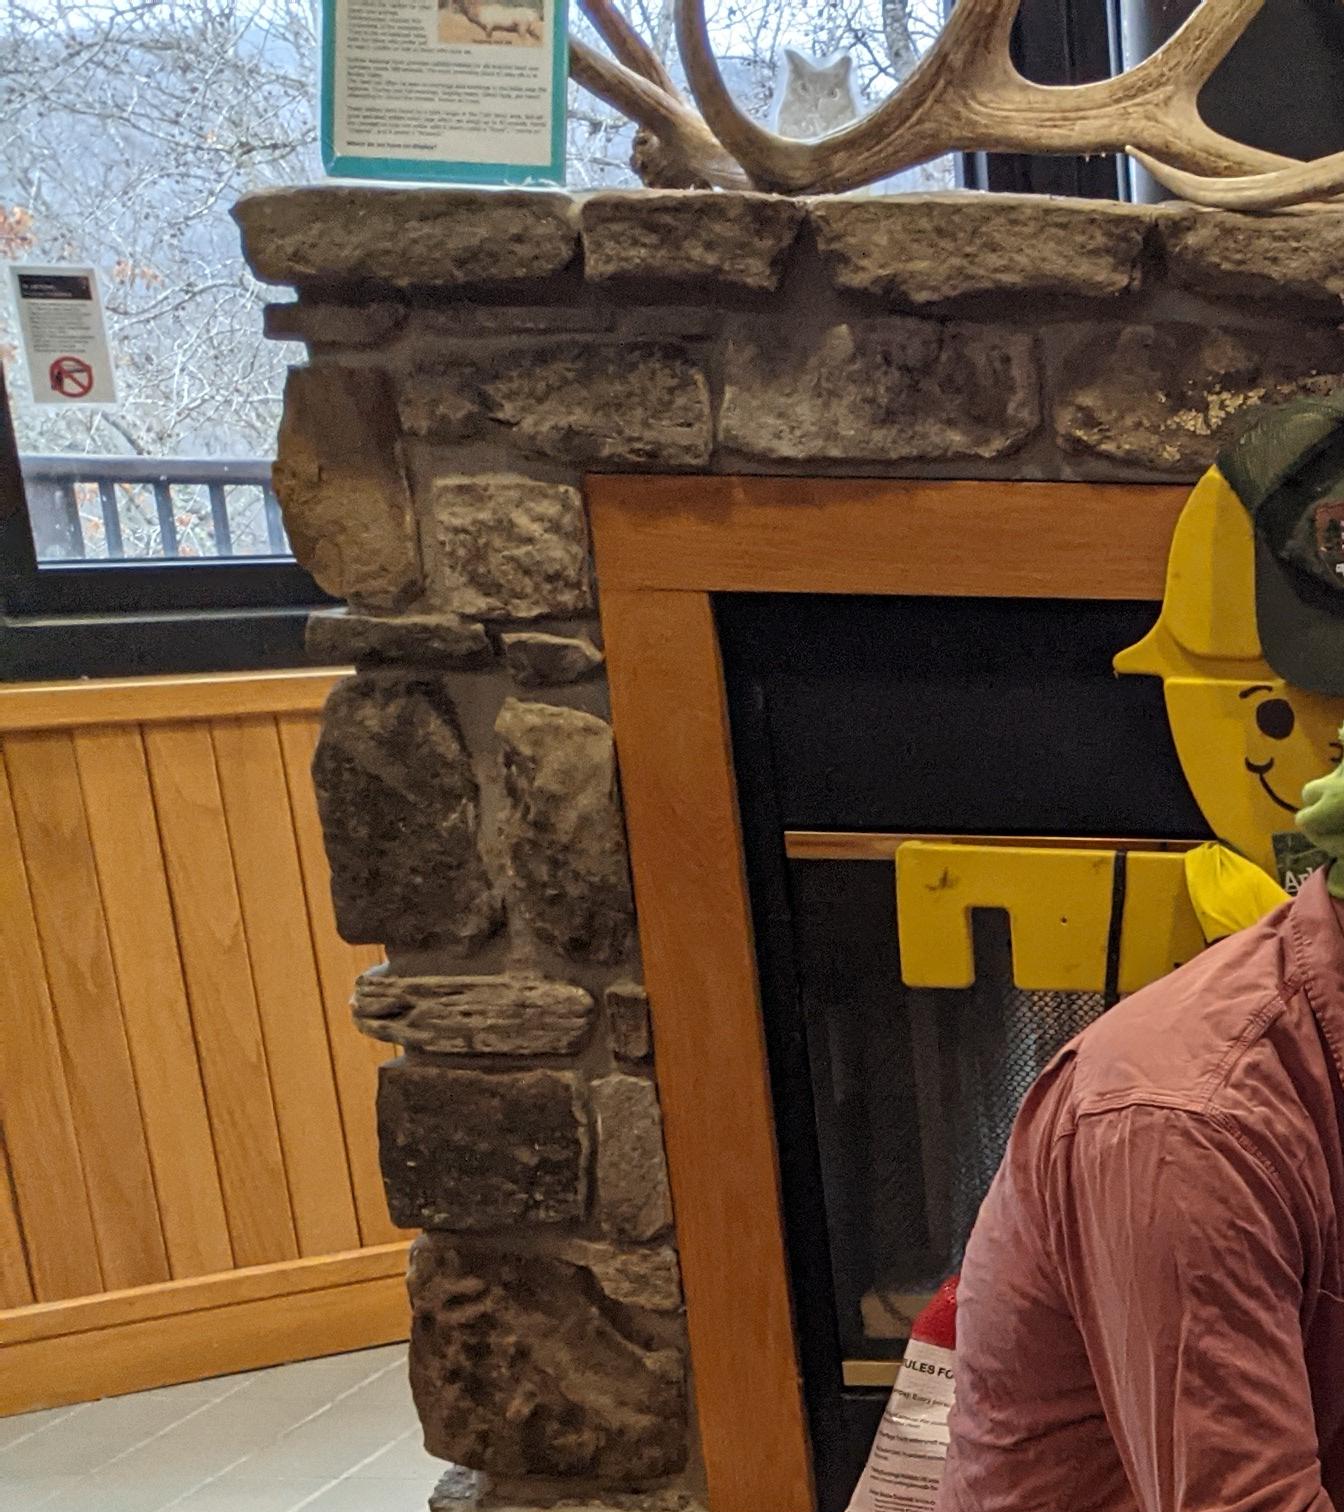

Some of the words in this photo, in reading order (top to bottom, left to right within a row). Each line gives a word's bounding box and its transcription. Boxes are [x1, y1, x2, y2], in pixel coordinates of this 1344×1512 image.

[1285, 867, 1314, 893] Ar
[903, 1359, 936, 1375] ULES
[937, 1367, 955, 1380] FO
